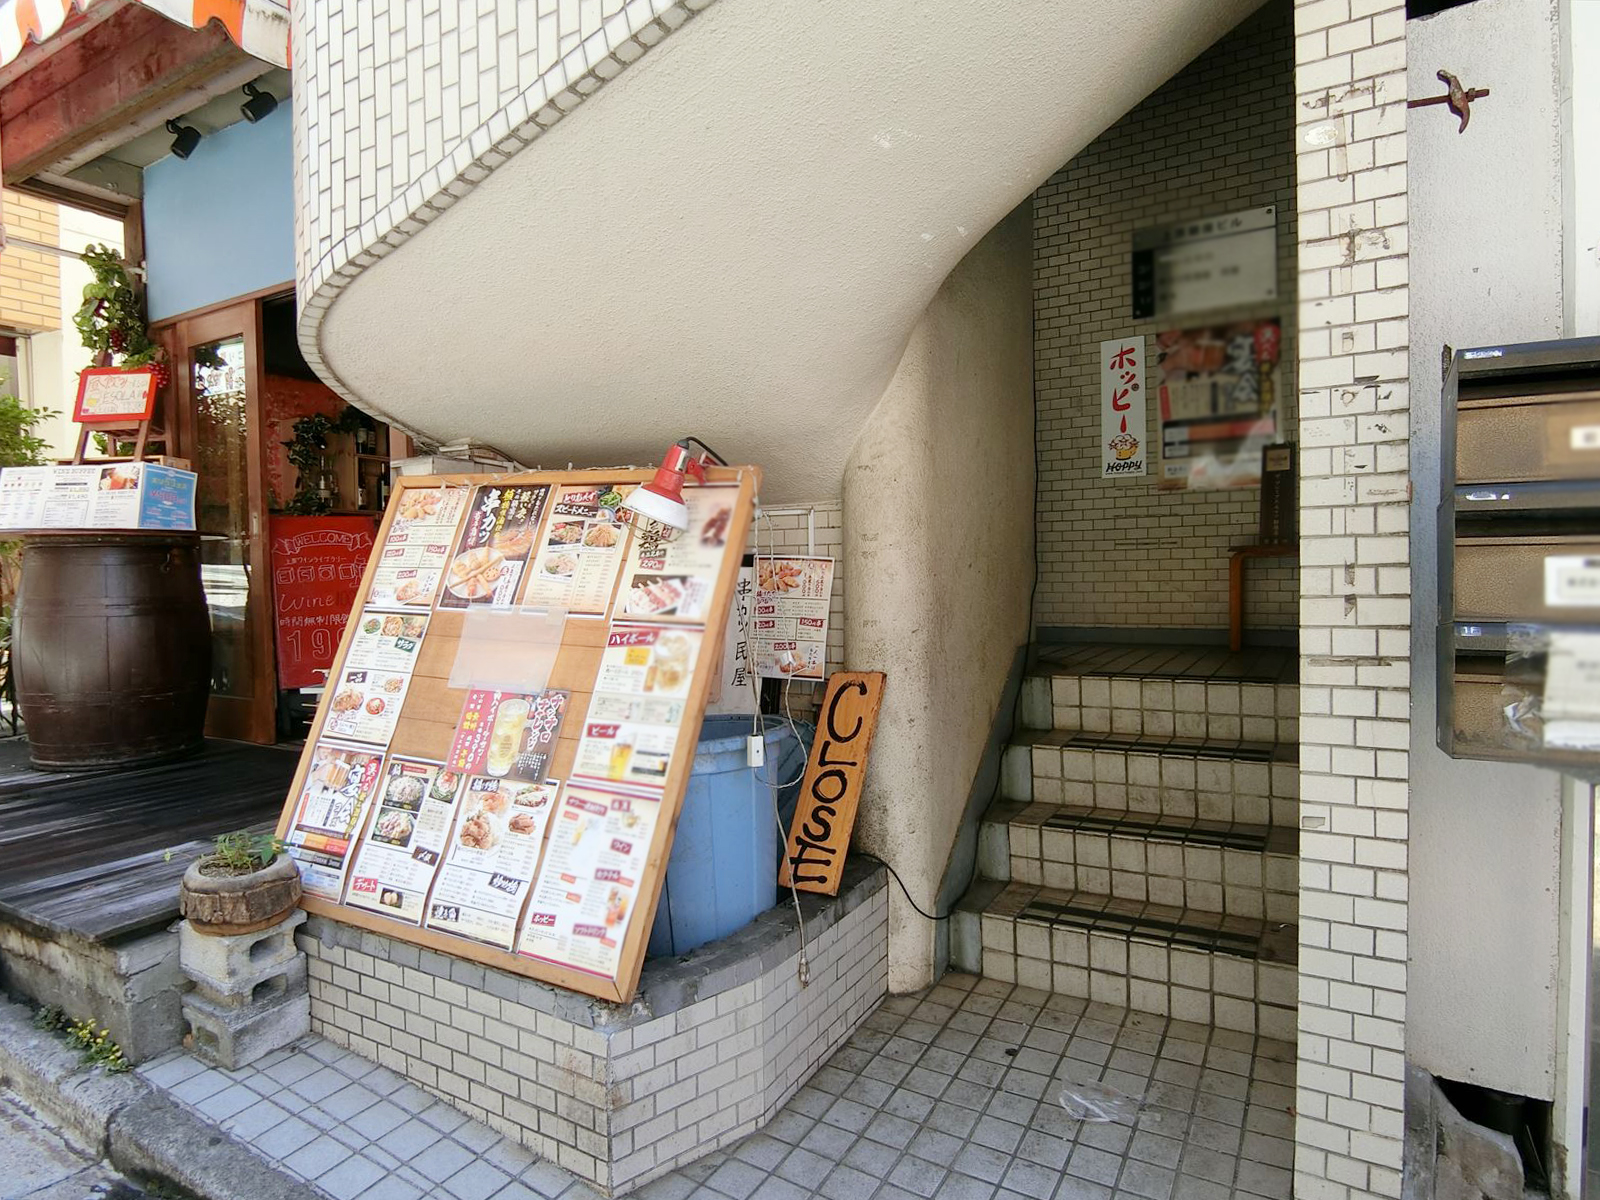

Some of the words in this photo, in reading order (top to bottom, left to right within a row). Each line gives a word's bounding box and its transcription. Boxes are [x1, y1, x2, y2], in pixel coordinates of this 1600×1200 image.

[1110, 343, 1136, 434] ホッピー
[295, 533, 351, 546] WELCOME
[280, 594, 335, 612] Wine
[611, 631, 655, 644] ハイボール
[591, 726, 616, 736] ビール
[789, 680, 868, 885] CLOSE
